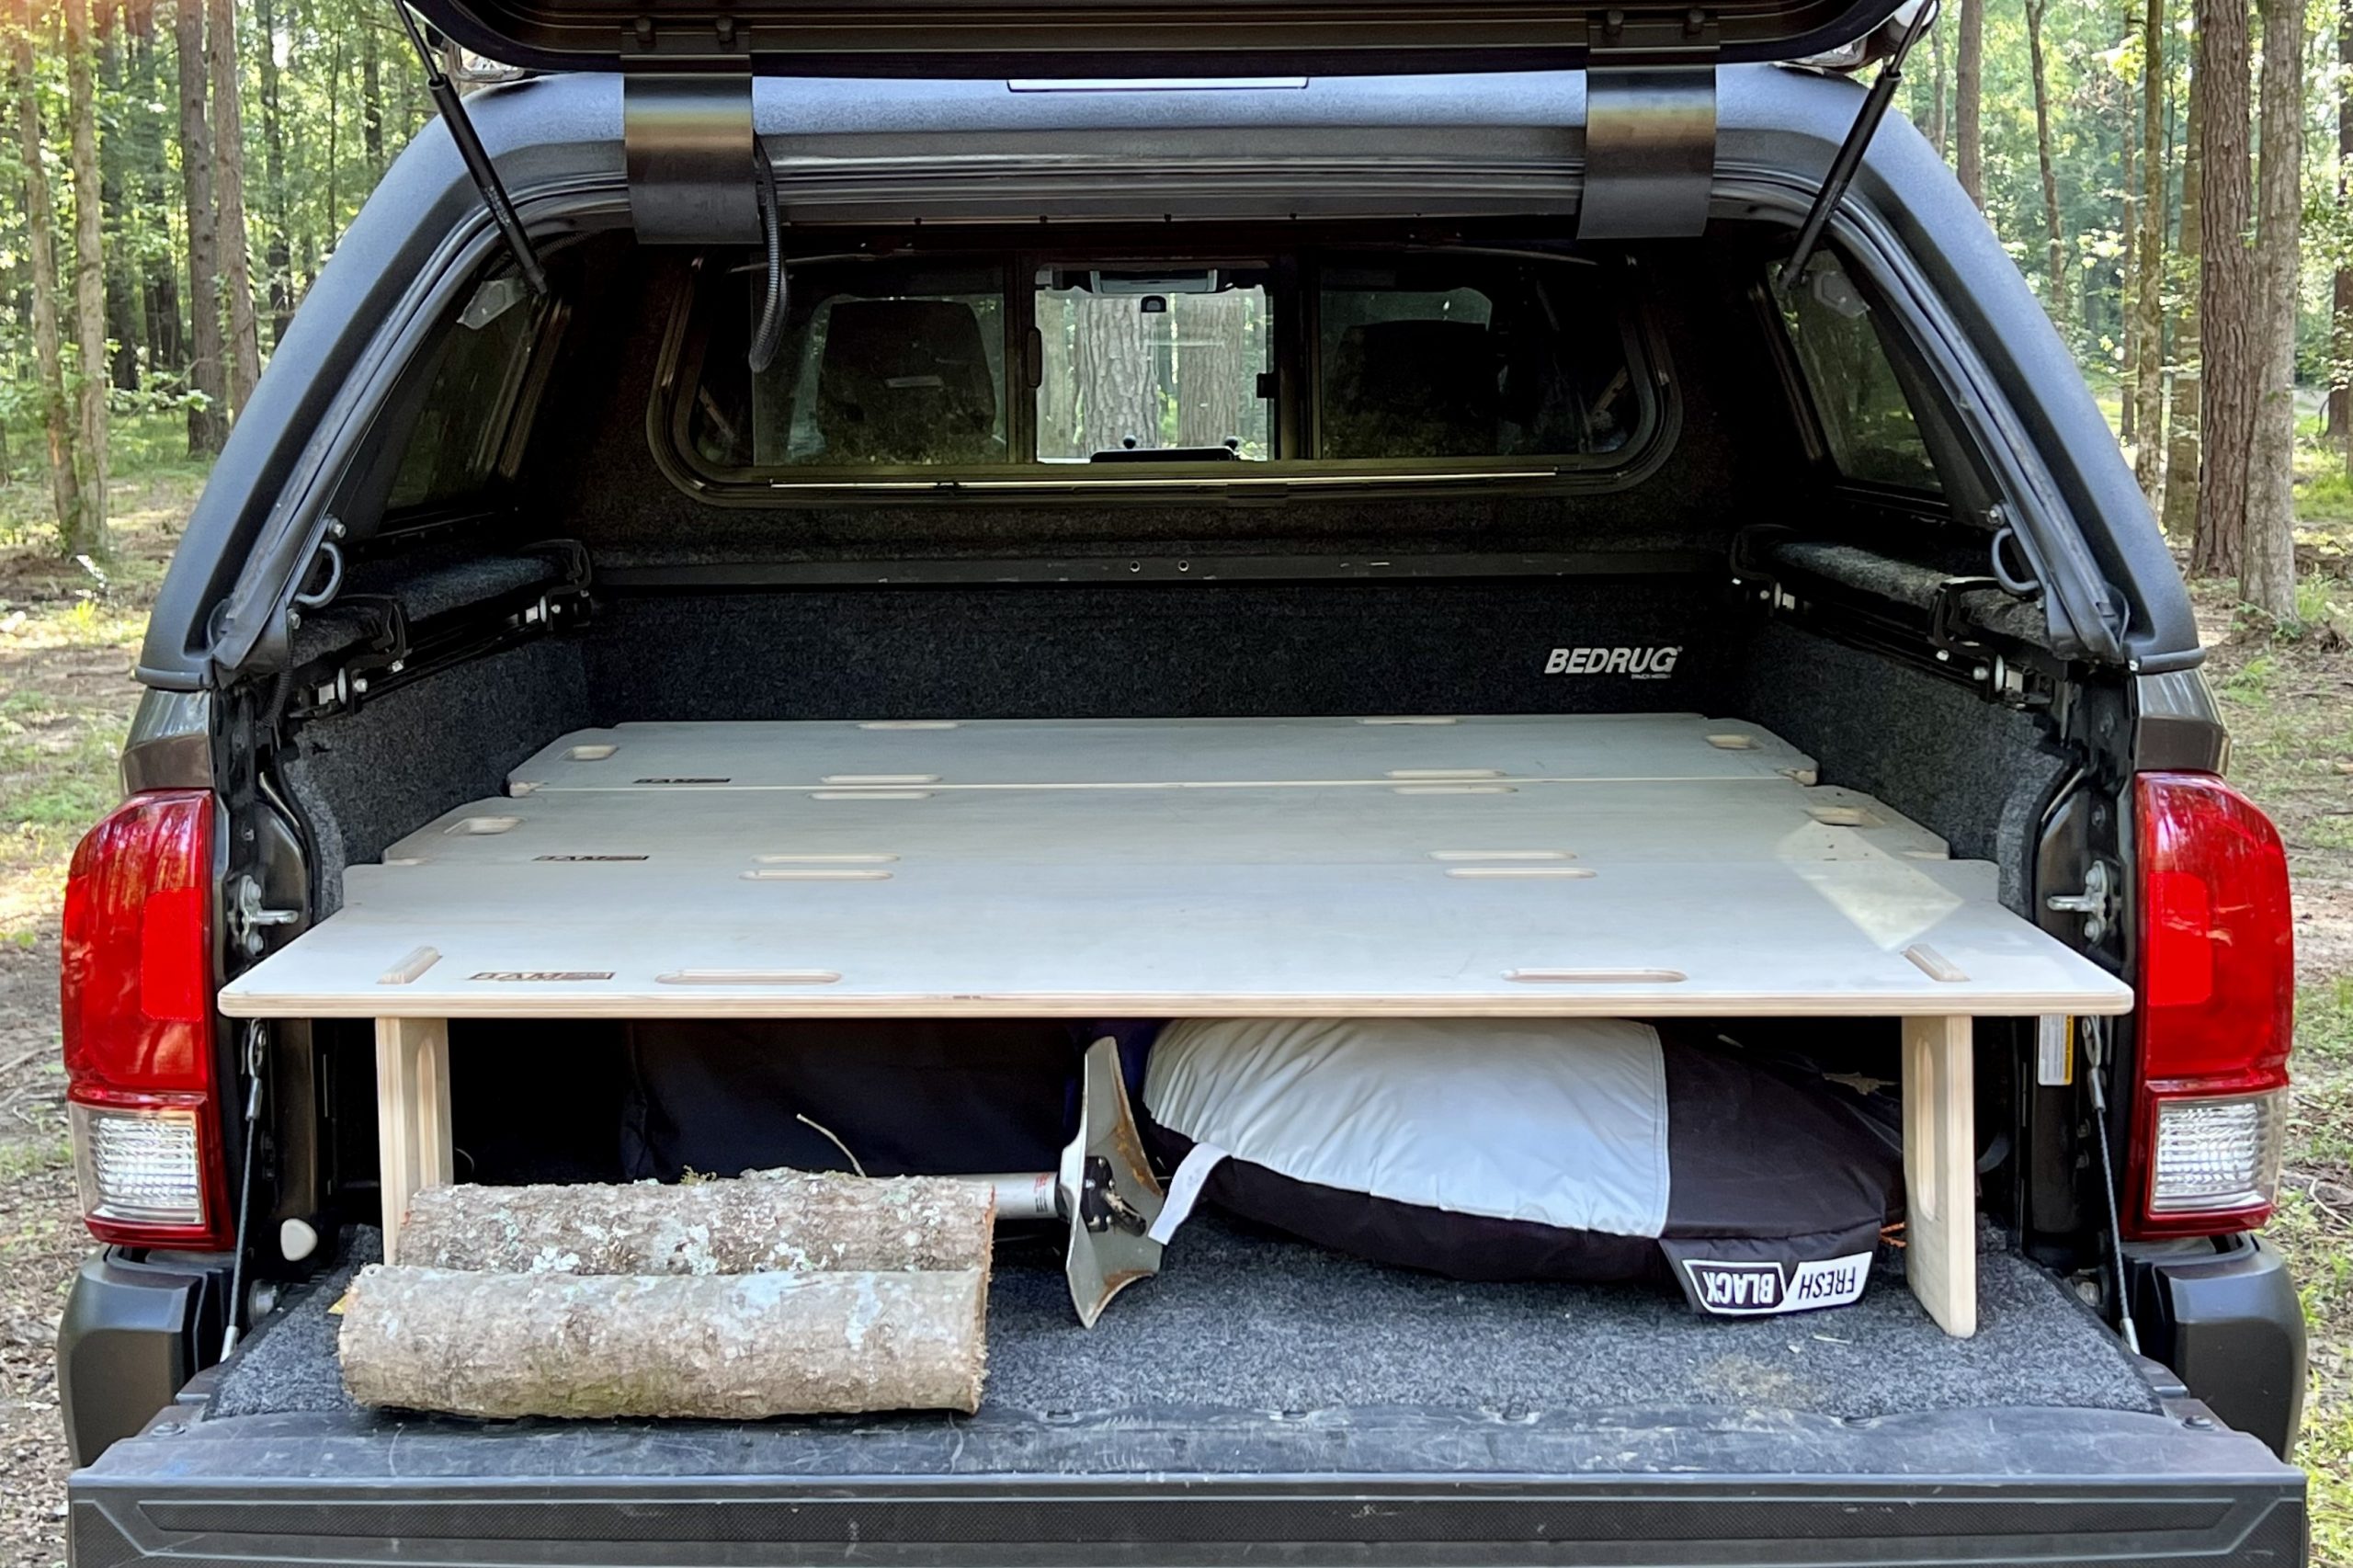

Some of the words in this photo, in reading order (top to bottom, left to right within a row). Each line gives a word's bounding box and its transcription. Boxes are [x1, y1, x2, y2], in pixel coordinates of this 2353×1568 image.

[1544, 647, 1678, 674] BEDRUG
[1702, 1271, 1775, 1304] BLACK
[1798, 1267, 1856, 1300] FRESH
